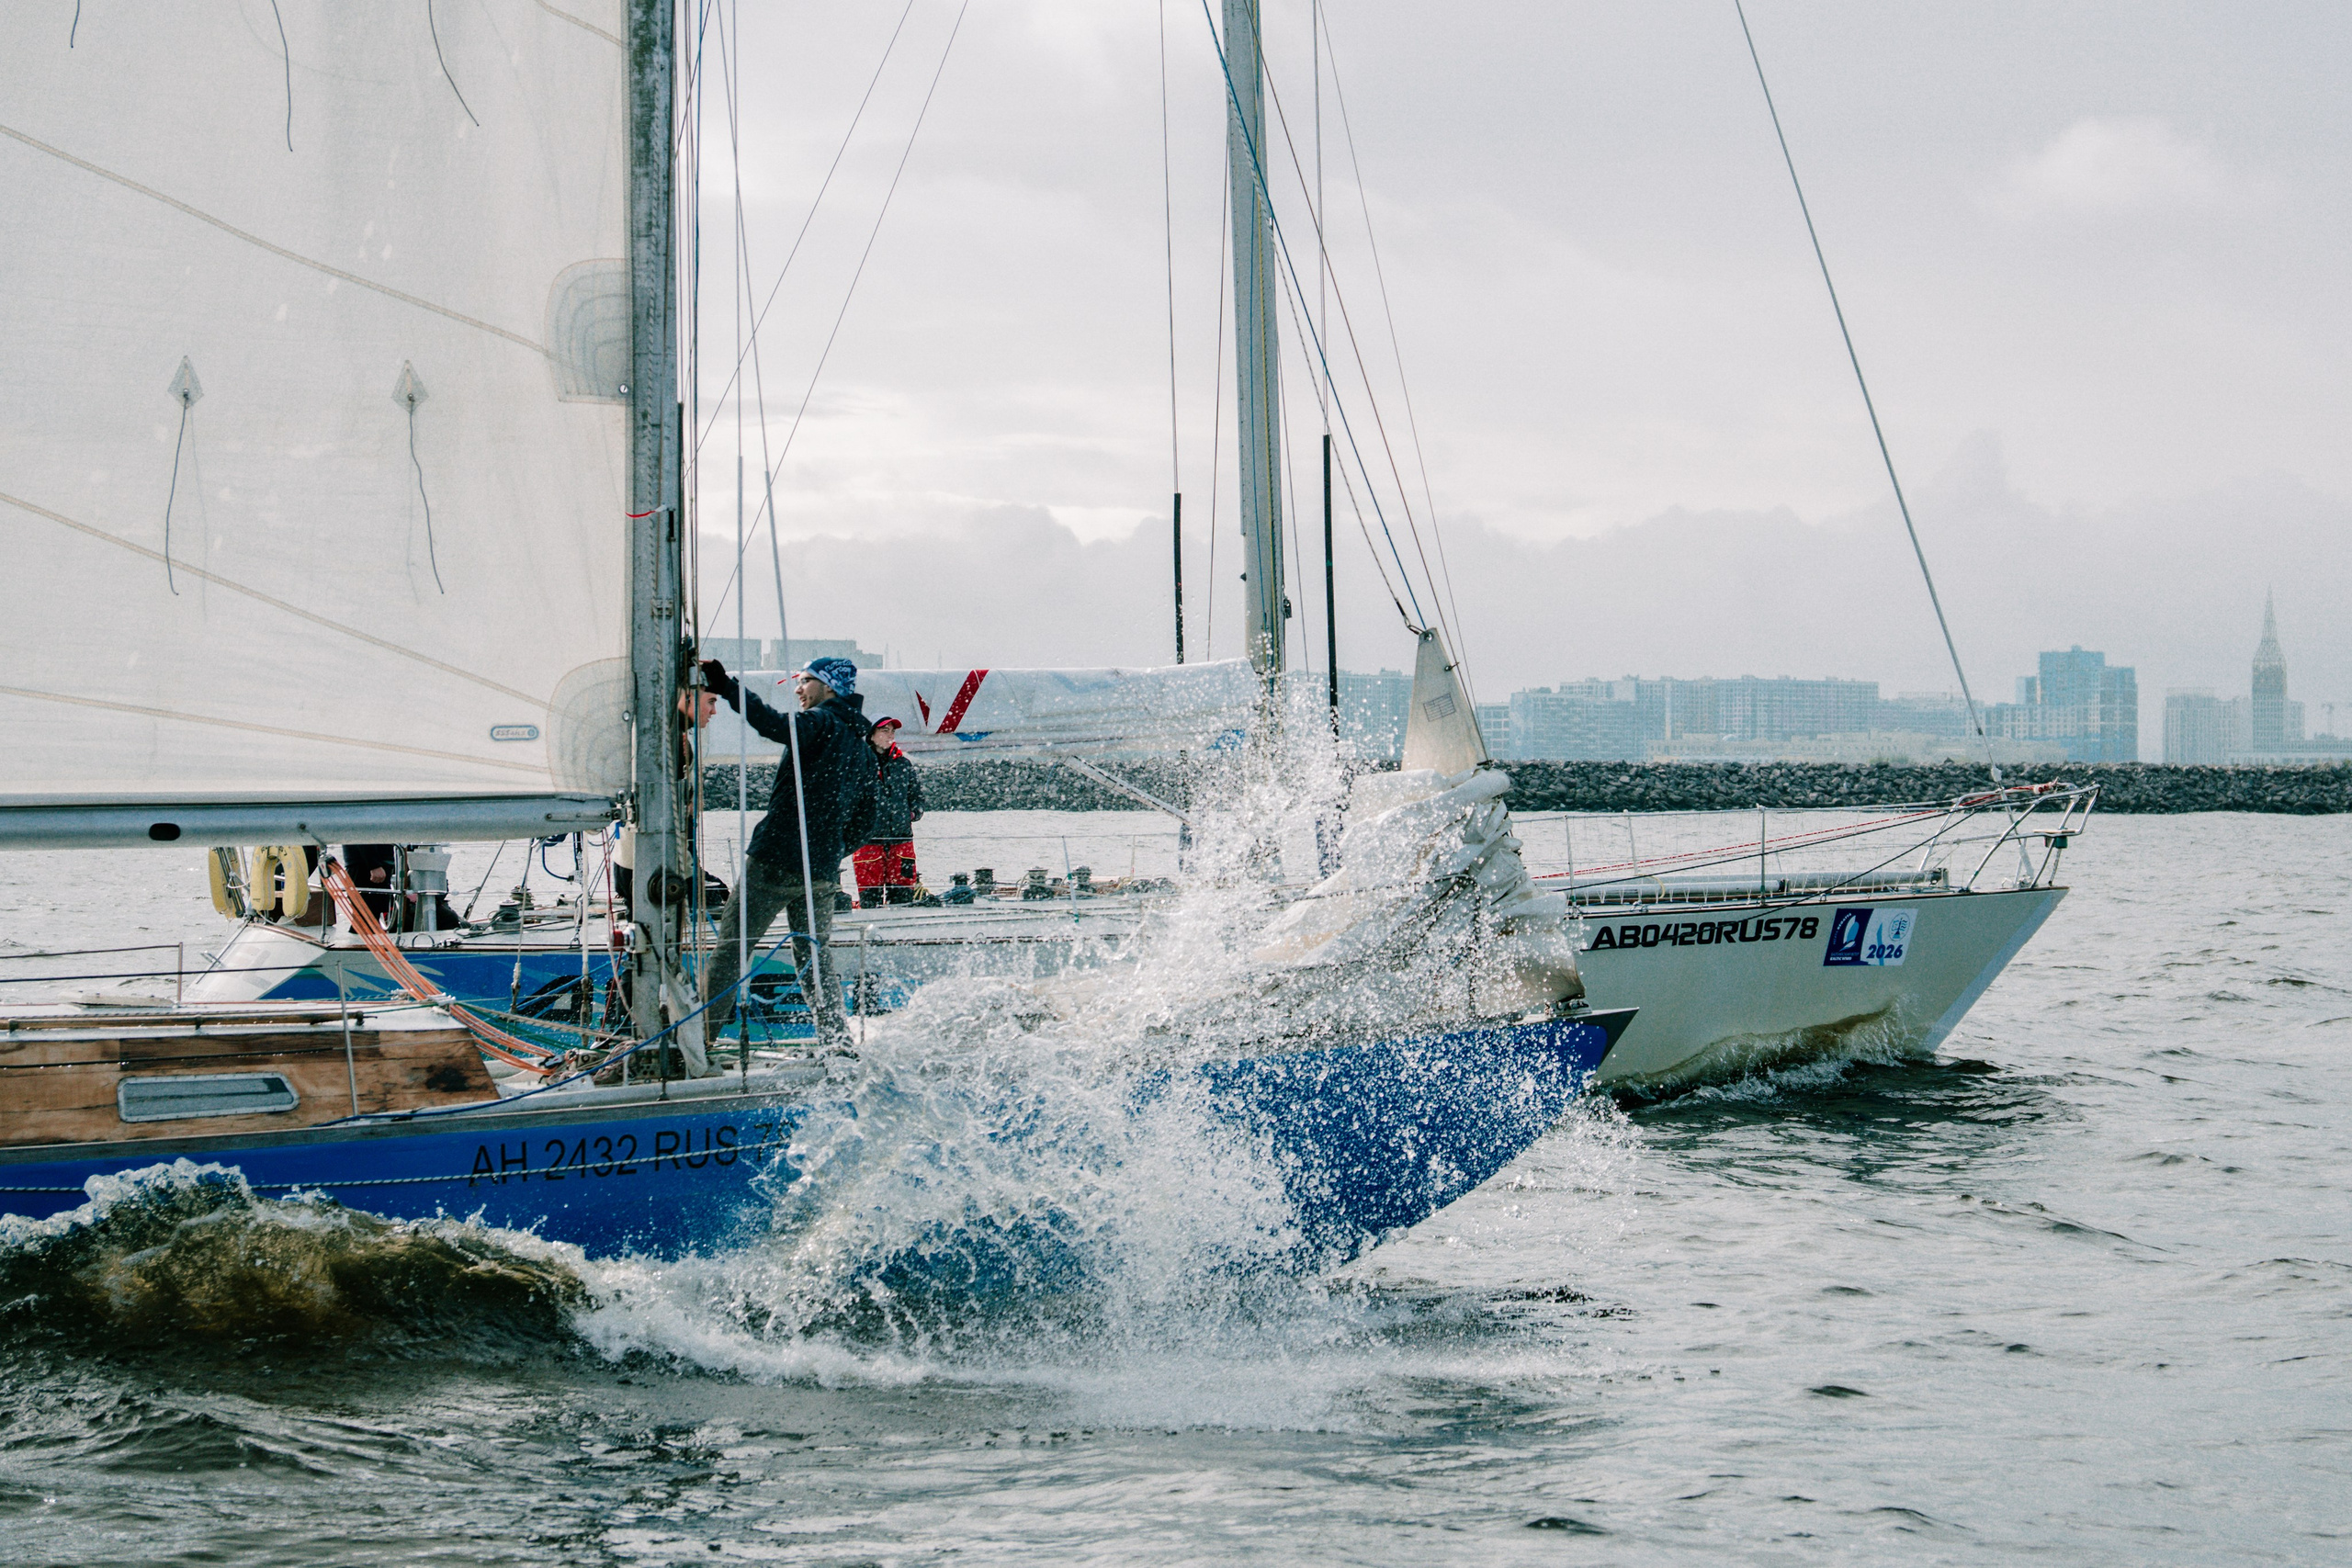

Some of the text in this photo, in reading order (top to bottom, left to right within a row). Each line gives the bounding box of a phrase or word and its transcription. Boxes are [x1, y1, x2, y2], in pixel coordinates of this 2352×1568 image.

[1866, 944, 1904, 959] 2026
[469, 1141, 527, 1187] AH
[545, 1134, 638, 1180] 2432
[654, 1125, 738, 1171] RUS
